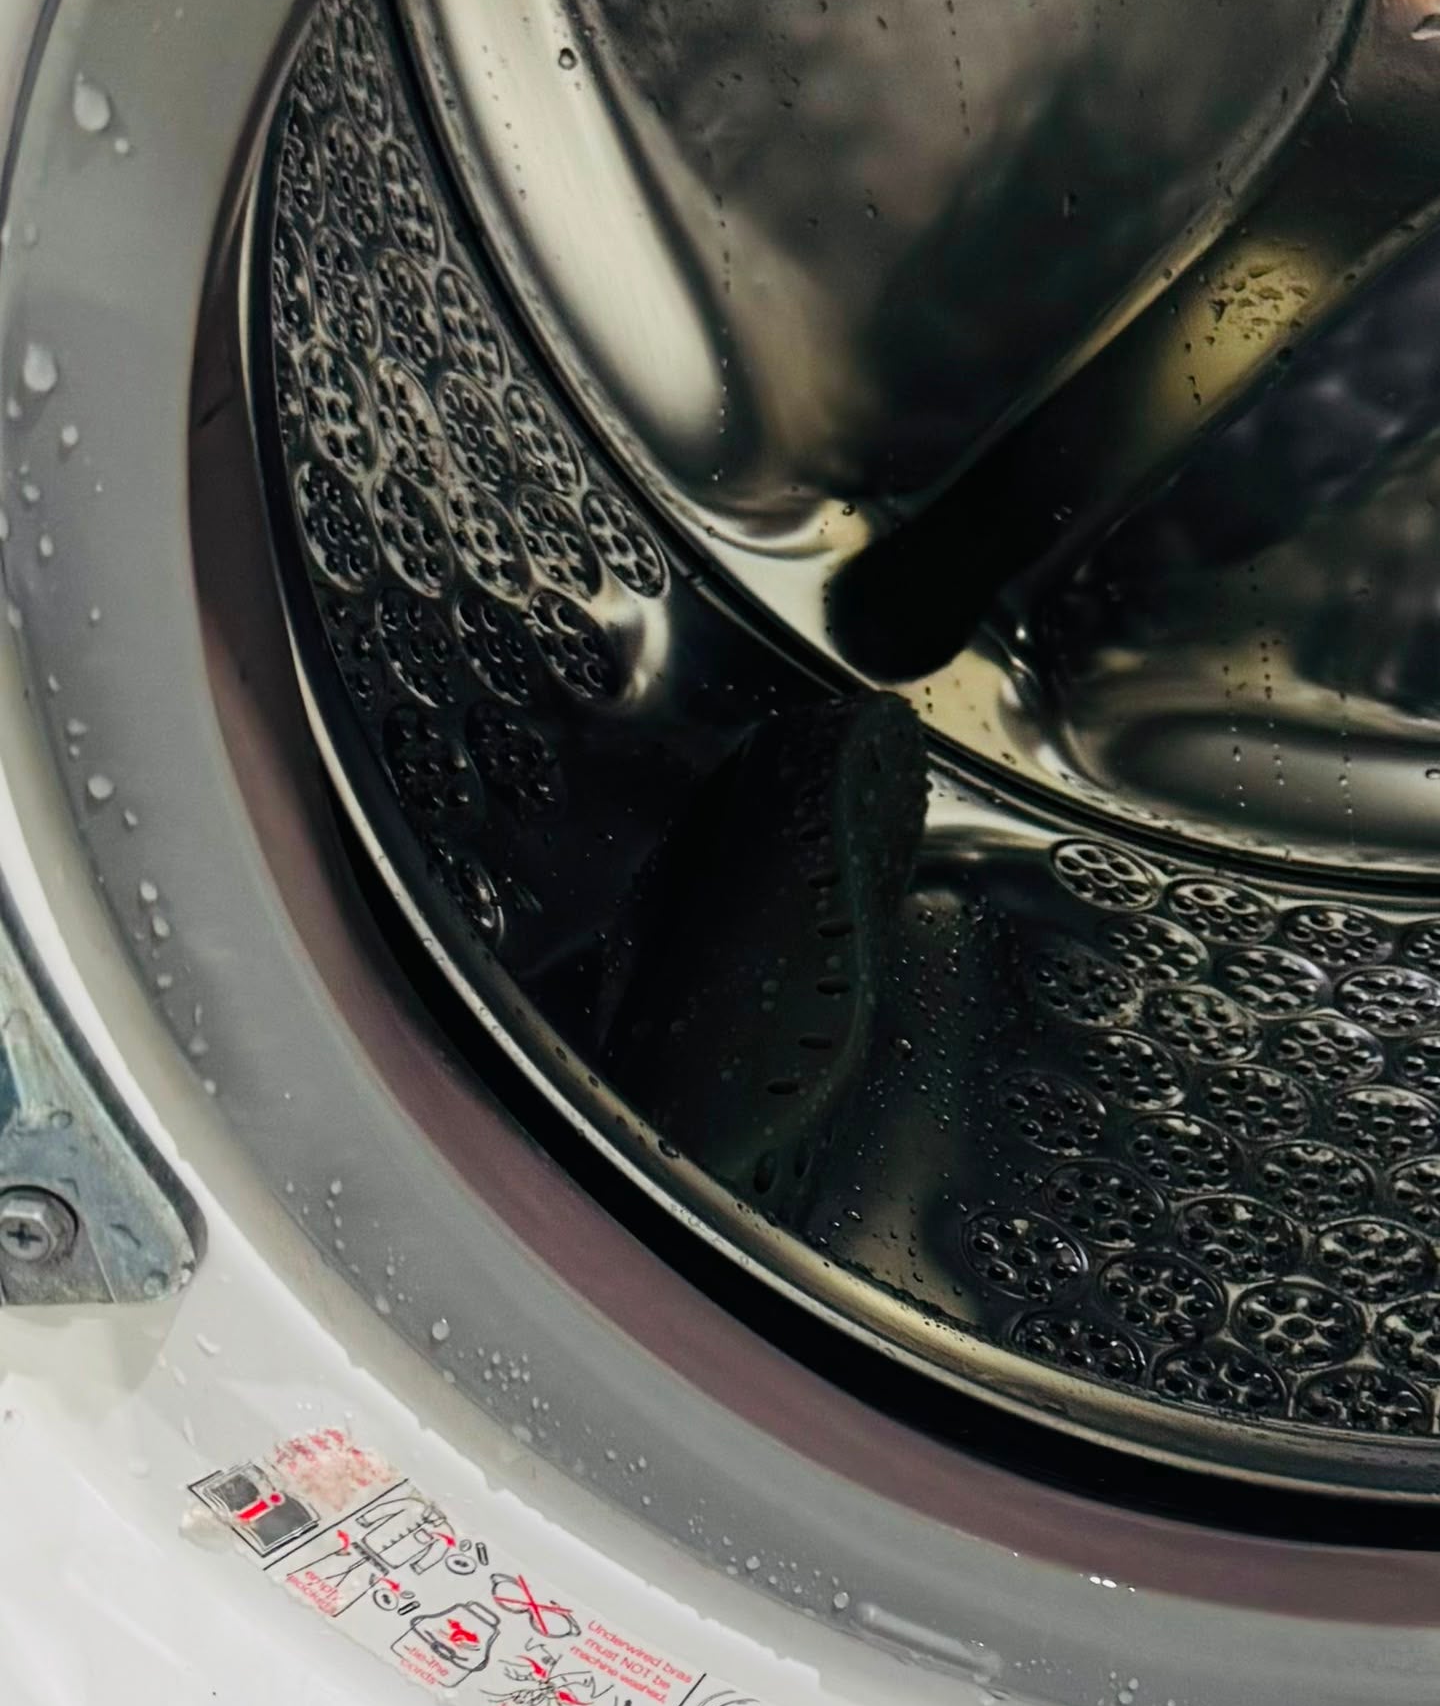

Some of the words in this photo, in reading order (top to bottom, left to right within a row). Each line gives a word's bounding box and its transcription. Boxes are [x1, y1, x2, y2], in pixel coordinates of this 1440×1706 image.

[570, 1645, 618, 1676] machine
[585, 1638, 619, 1661] must
[620, 1656, 652, 1678] NOT
[652, 1674, 671, 1690] be
[588, 1620, 662, 1667] Underwired
[662, 1662, 692, 1683] bras
